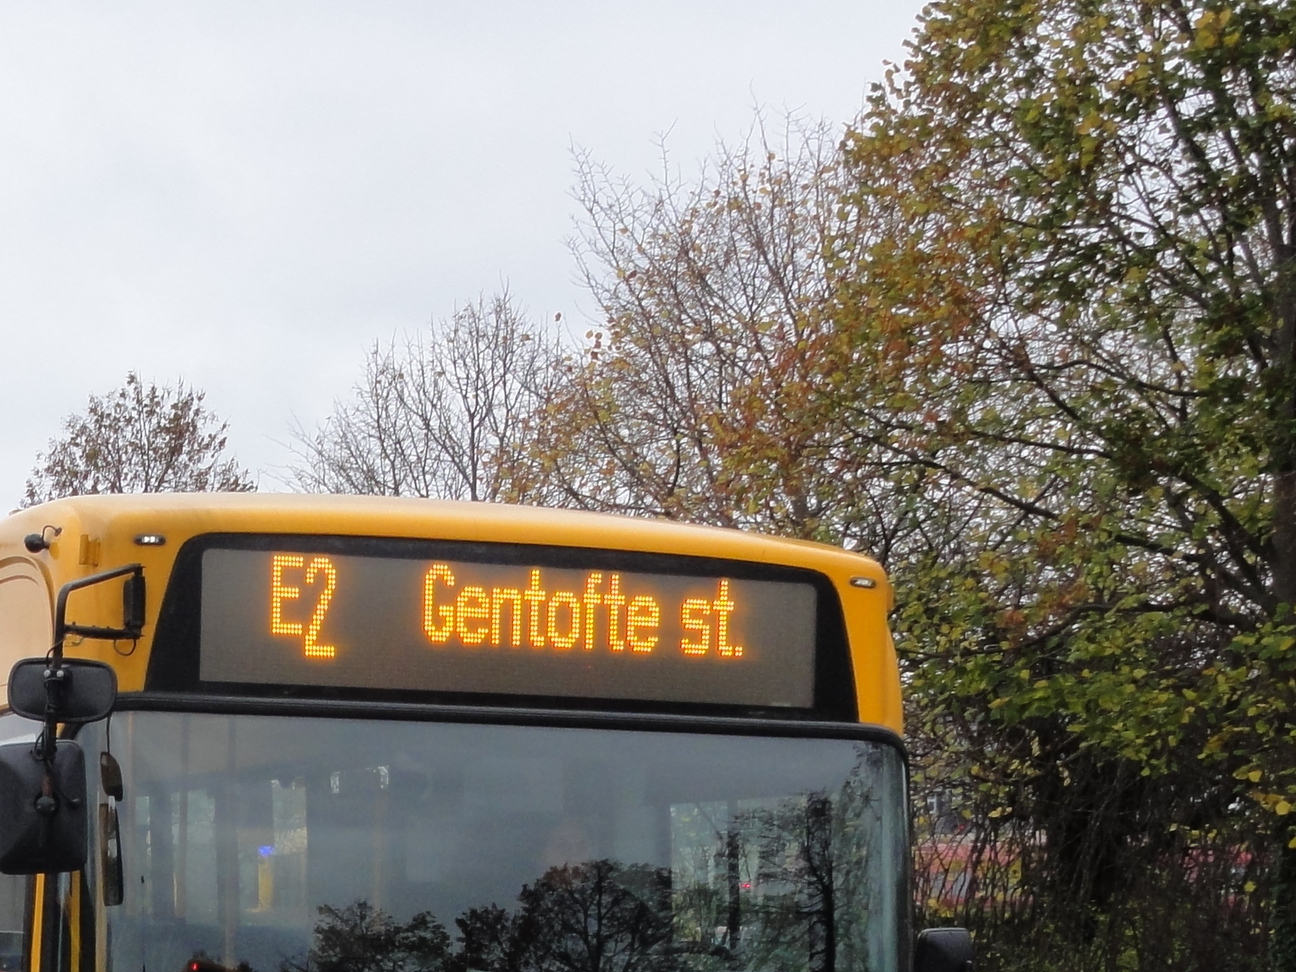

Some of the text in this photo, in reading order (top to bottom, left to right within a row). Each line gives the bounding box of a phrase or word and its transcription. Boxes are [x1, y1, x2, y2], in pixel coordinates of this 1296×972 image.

[270, 554, 744, 658] E2 Gentofte st.
